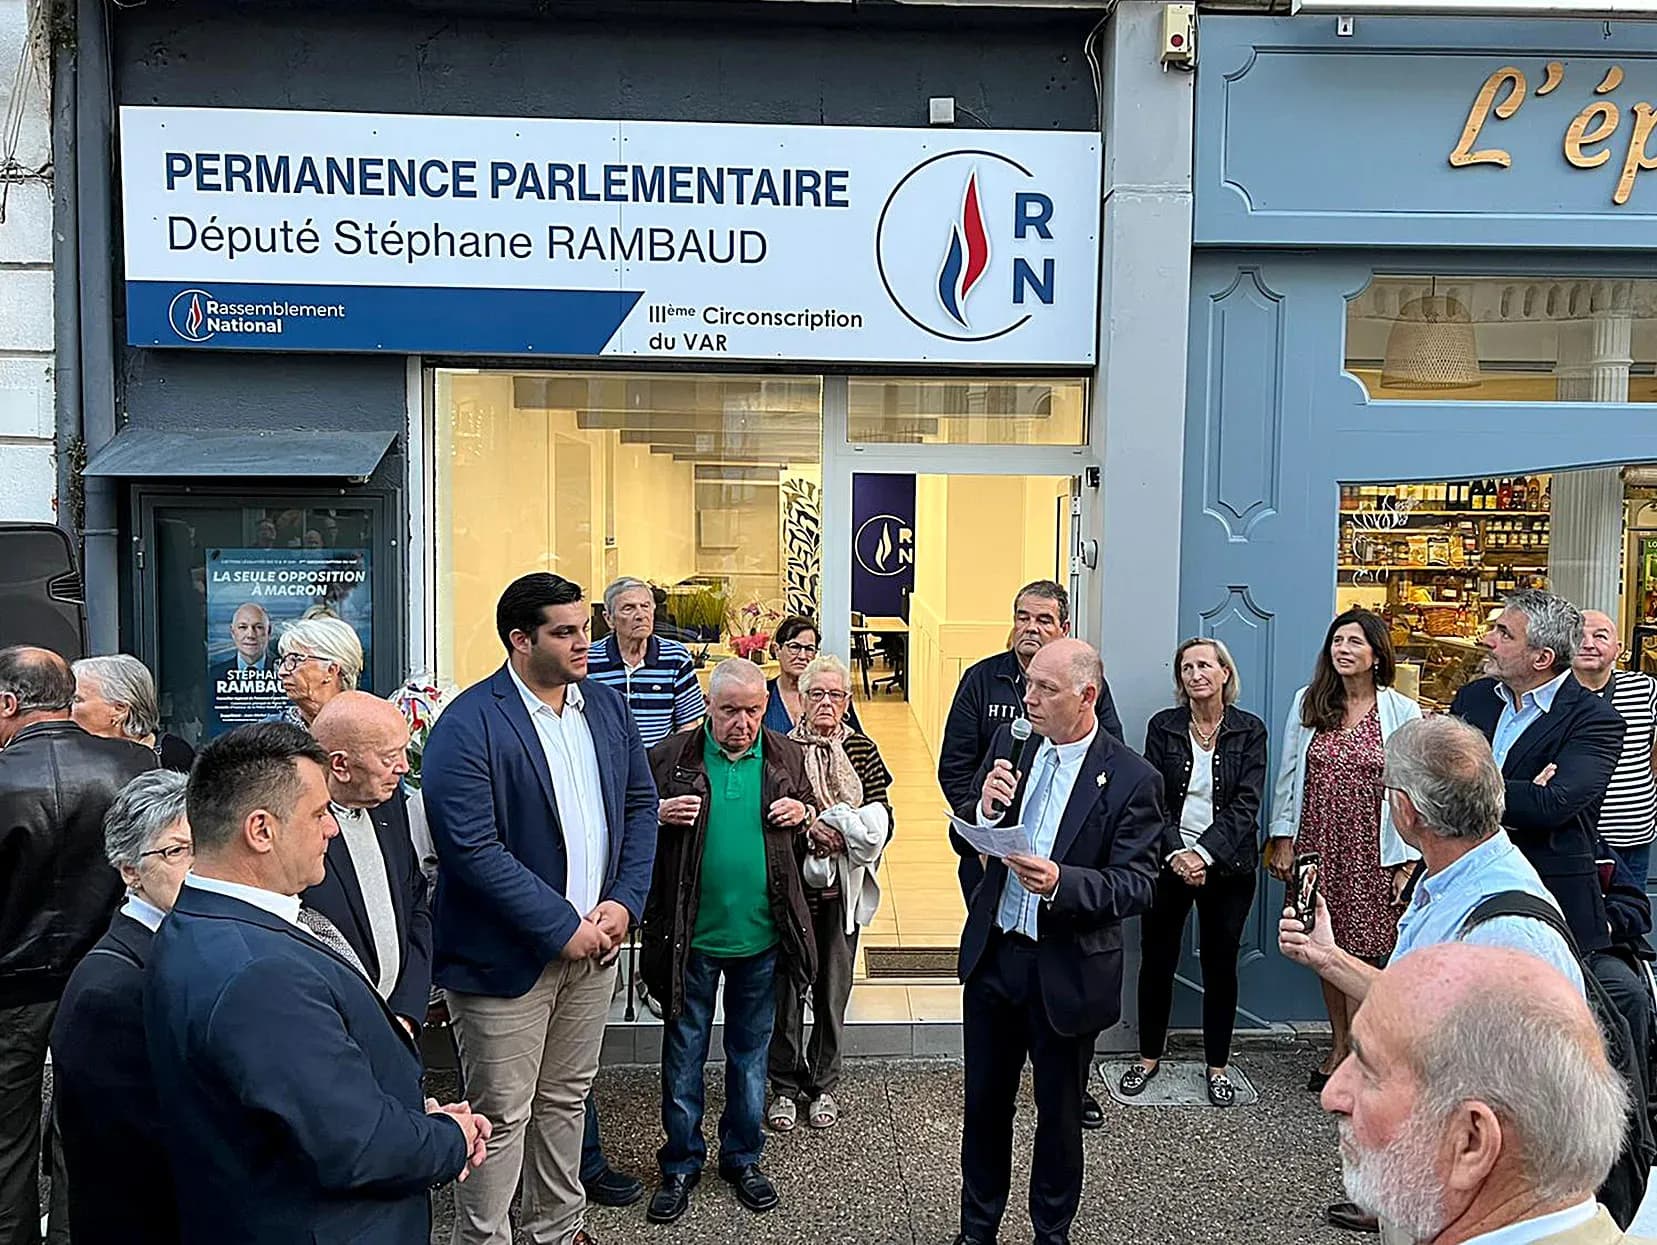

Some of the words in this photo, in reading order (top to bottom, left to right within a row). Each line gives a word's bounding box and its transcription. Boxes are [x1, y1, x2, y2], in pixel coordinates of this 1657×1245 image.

[166, 153, 477, 198] PERMANENCE
[490, 162, 850, 207] PARLEMENTAIRE
[1014, 192, 1054, 239] R
[168, 215, 320, 258] Député
[334, 219, 532, 263] Stéphane
[547, 225, 767, 264] RAMBAUD
[1013, 258, 1055, 304] N
[206, 300, 346, 318] Rassemblement
[702, 306, 864, 331] Circonscription
[207, 317, 283, 333] National
[649, 332, 676, 351] du
[683, 333, 728, 352] VAR
[212, 571, 231, 582] LA
[233, 571, 276, 582] SEULE
[278, 571, 365, 583] OPPOSITION
[251, 582, 262, 596] À
[264, 585, 327, 596] MACRON
[216, 680, 286, 693] RAMBAU
